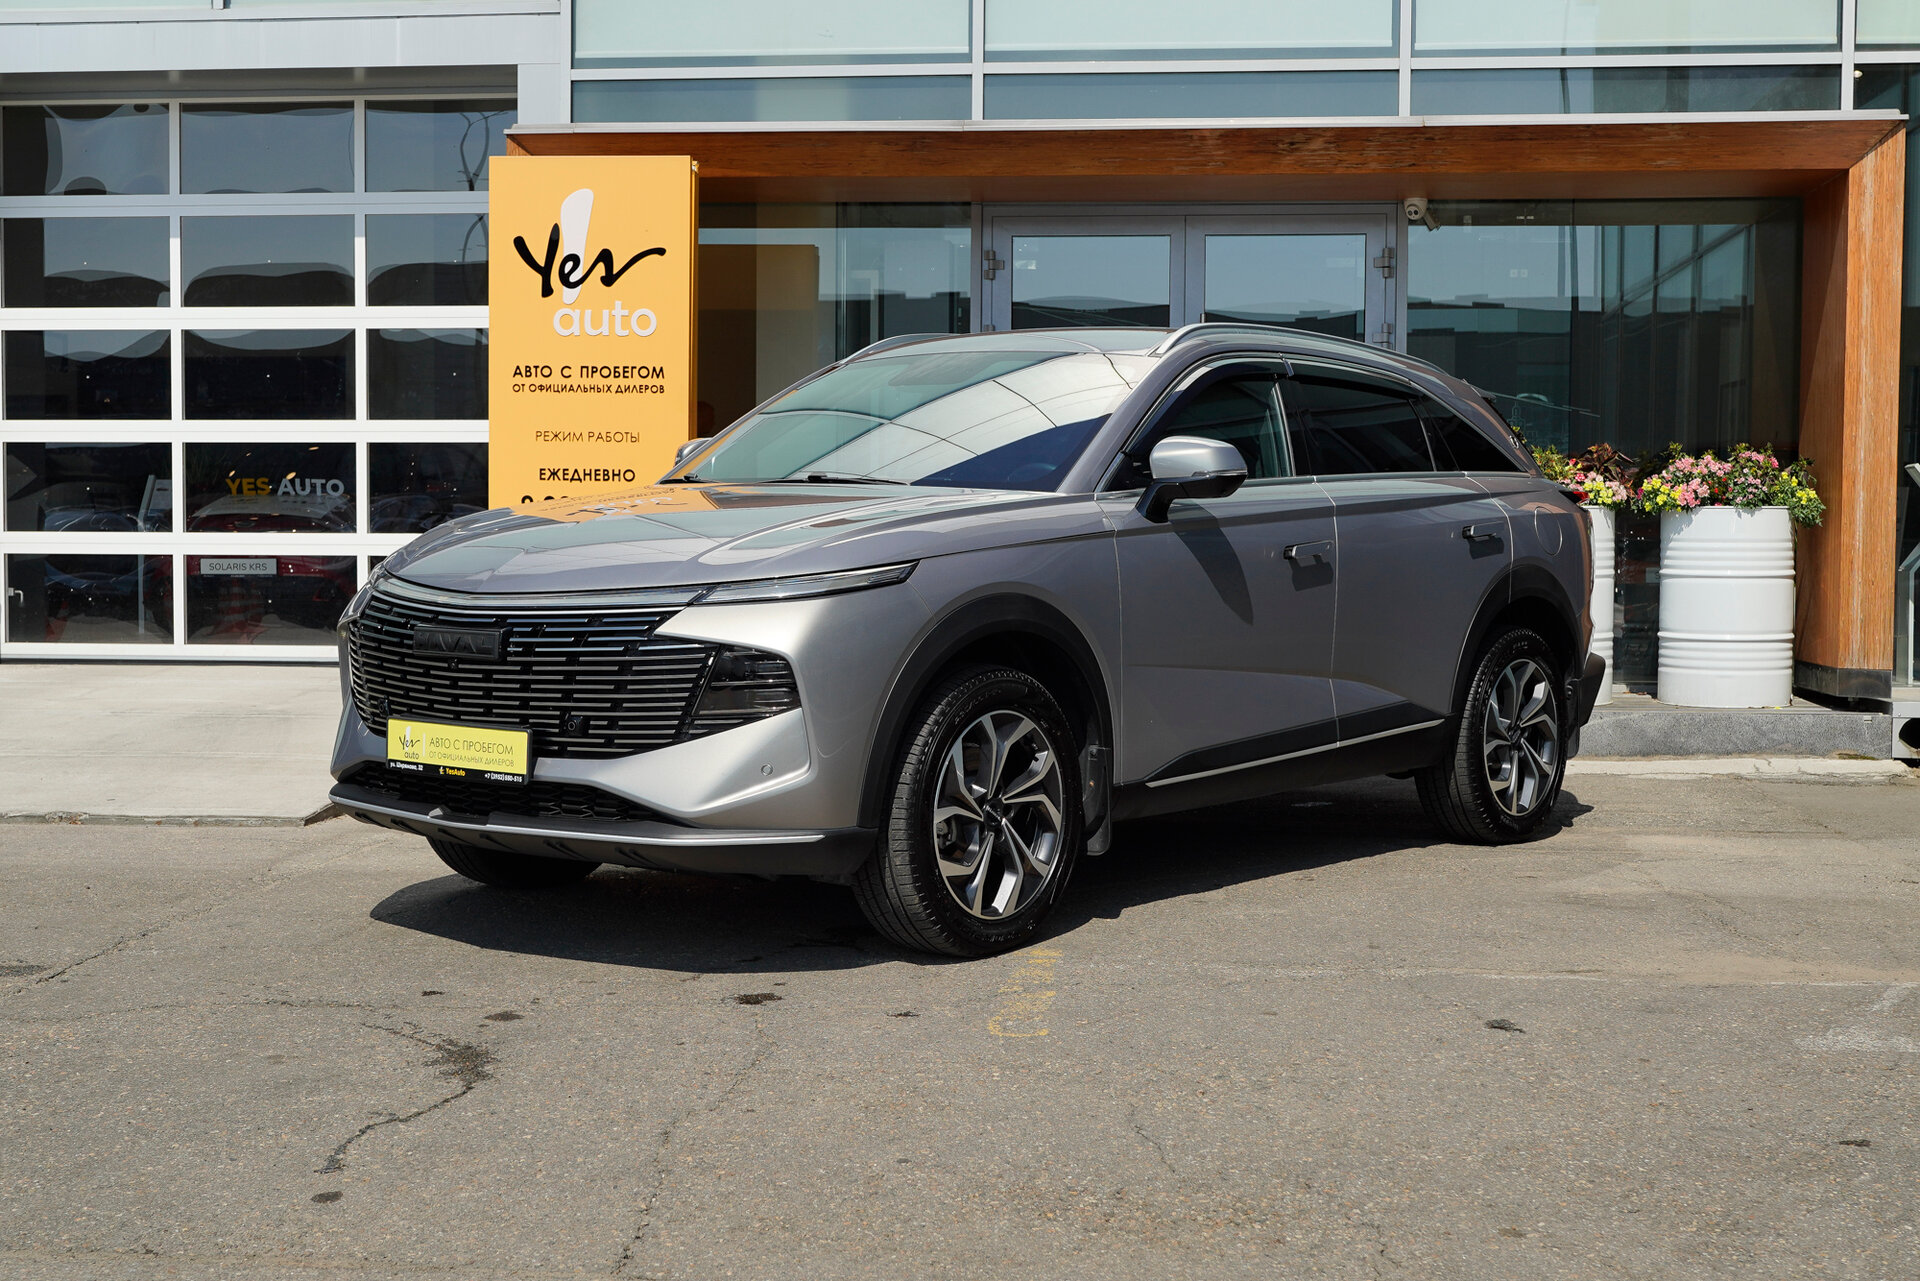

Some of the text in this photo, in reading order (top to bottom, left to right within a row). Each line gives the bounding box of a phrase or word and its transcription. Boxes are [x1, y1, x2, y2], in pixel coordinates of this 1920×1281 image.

[513, 222, 667, 298] Yes
[553, 300, 657, 337] auto
[512, 365, 665, 380] АВТО С ПРОБЕГОМ
[512, 383, 665, 395] ОТ ОФИЦИАЛЬНЫХ ДИЛЕРОВ
[535, 430, 640, 444] РЕЖИМ РАБОТЫ
[539, 467, 636, 484] ЕЖЕДНЕВНО
[225, 477, 345, 497] YES AUTO
[208, 562, 268, 572] SOLARIS KRS
[429, 737, 514, 756] АВТО С ПРОБЕГОМ
[404, 751, 420, 760] auto
[428, 751, 515, 767] ОТ ОФИЦИАЛЬНЫХ ДИЛЕРОВ
